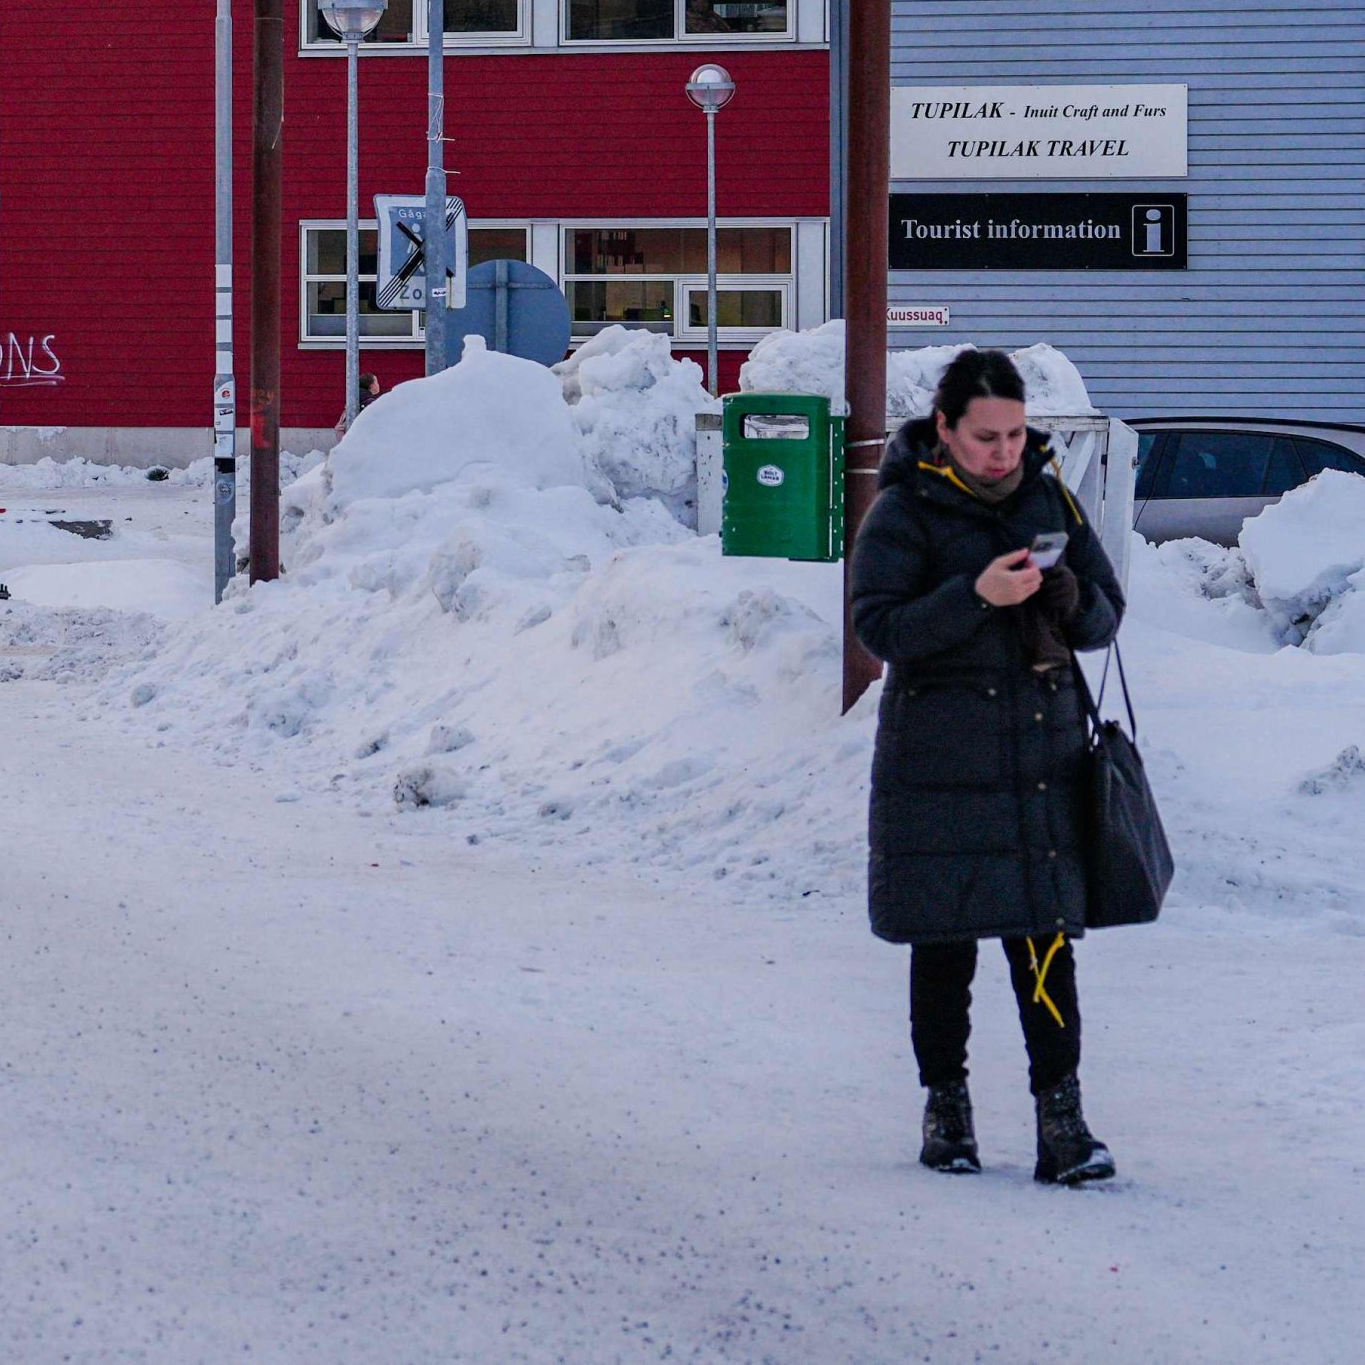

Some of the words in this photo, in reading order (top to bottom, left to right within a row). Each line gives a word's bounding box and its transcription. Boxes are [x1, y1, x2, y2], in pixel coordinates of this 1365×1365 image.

[911, 102, 1004, 119] TUPILAK
[1024, 105, 1058, 118] Inuit
[1063, 104, 1099, 120] Craft
[1102, 104, 1128, 117] and
[1133, 104, 1167, 117] Furs
[947, 140, 1041, 157] TUPILAK
[1047, 140, 1129, 157] TRAVEL
[901, 219, 981, 239] Tourist
[987, 219, 1121, 239] information
